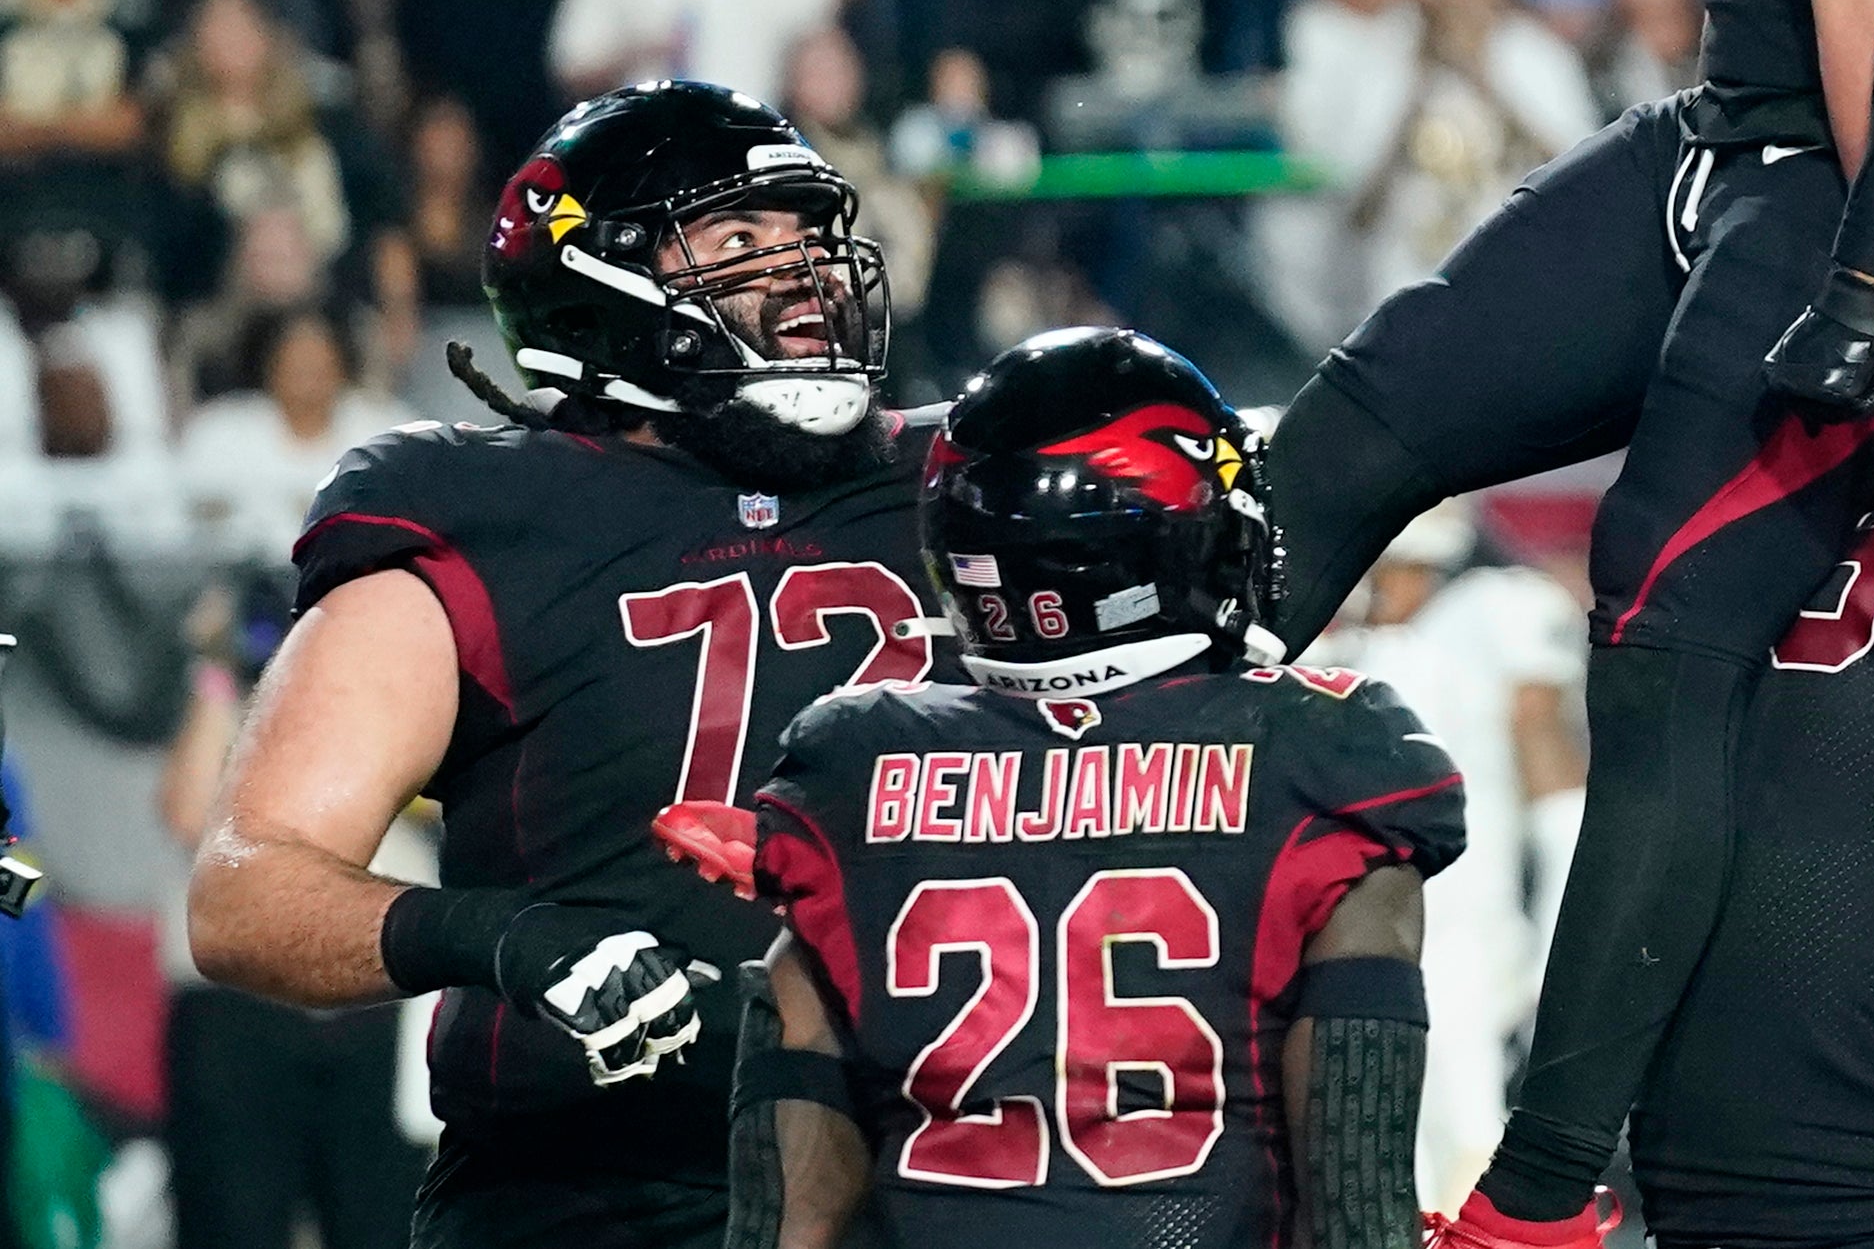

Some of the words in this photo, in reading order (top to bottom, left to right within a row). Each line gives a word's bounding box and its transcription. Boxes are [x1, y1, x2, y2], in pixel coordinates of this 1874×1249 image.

[979, 590, 1070, 640] 26
[618, 560, 934, 808] 72
[984, 664, 1129, 693] ARIZONA
[865, 743, 1255, 844] BENJAMIN
[886, 866, 1226, 1190] 26
